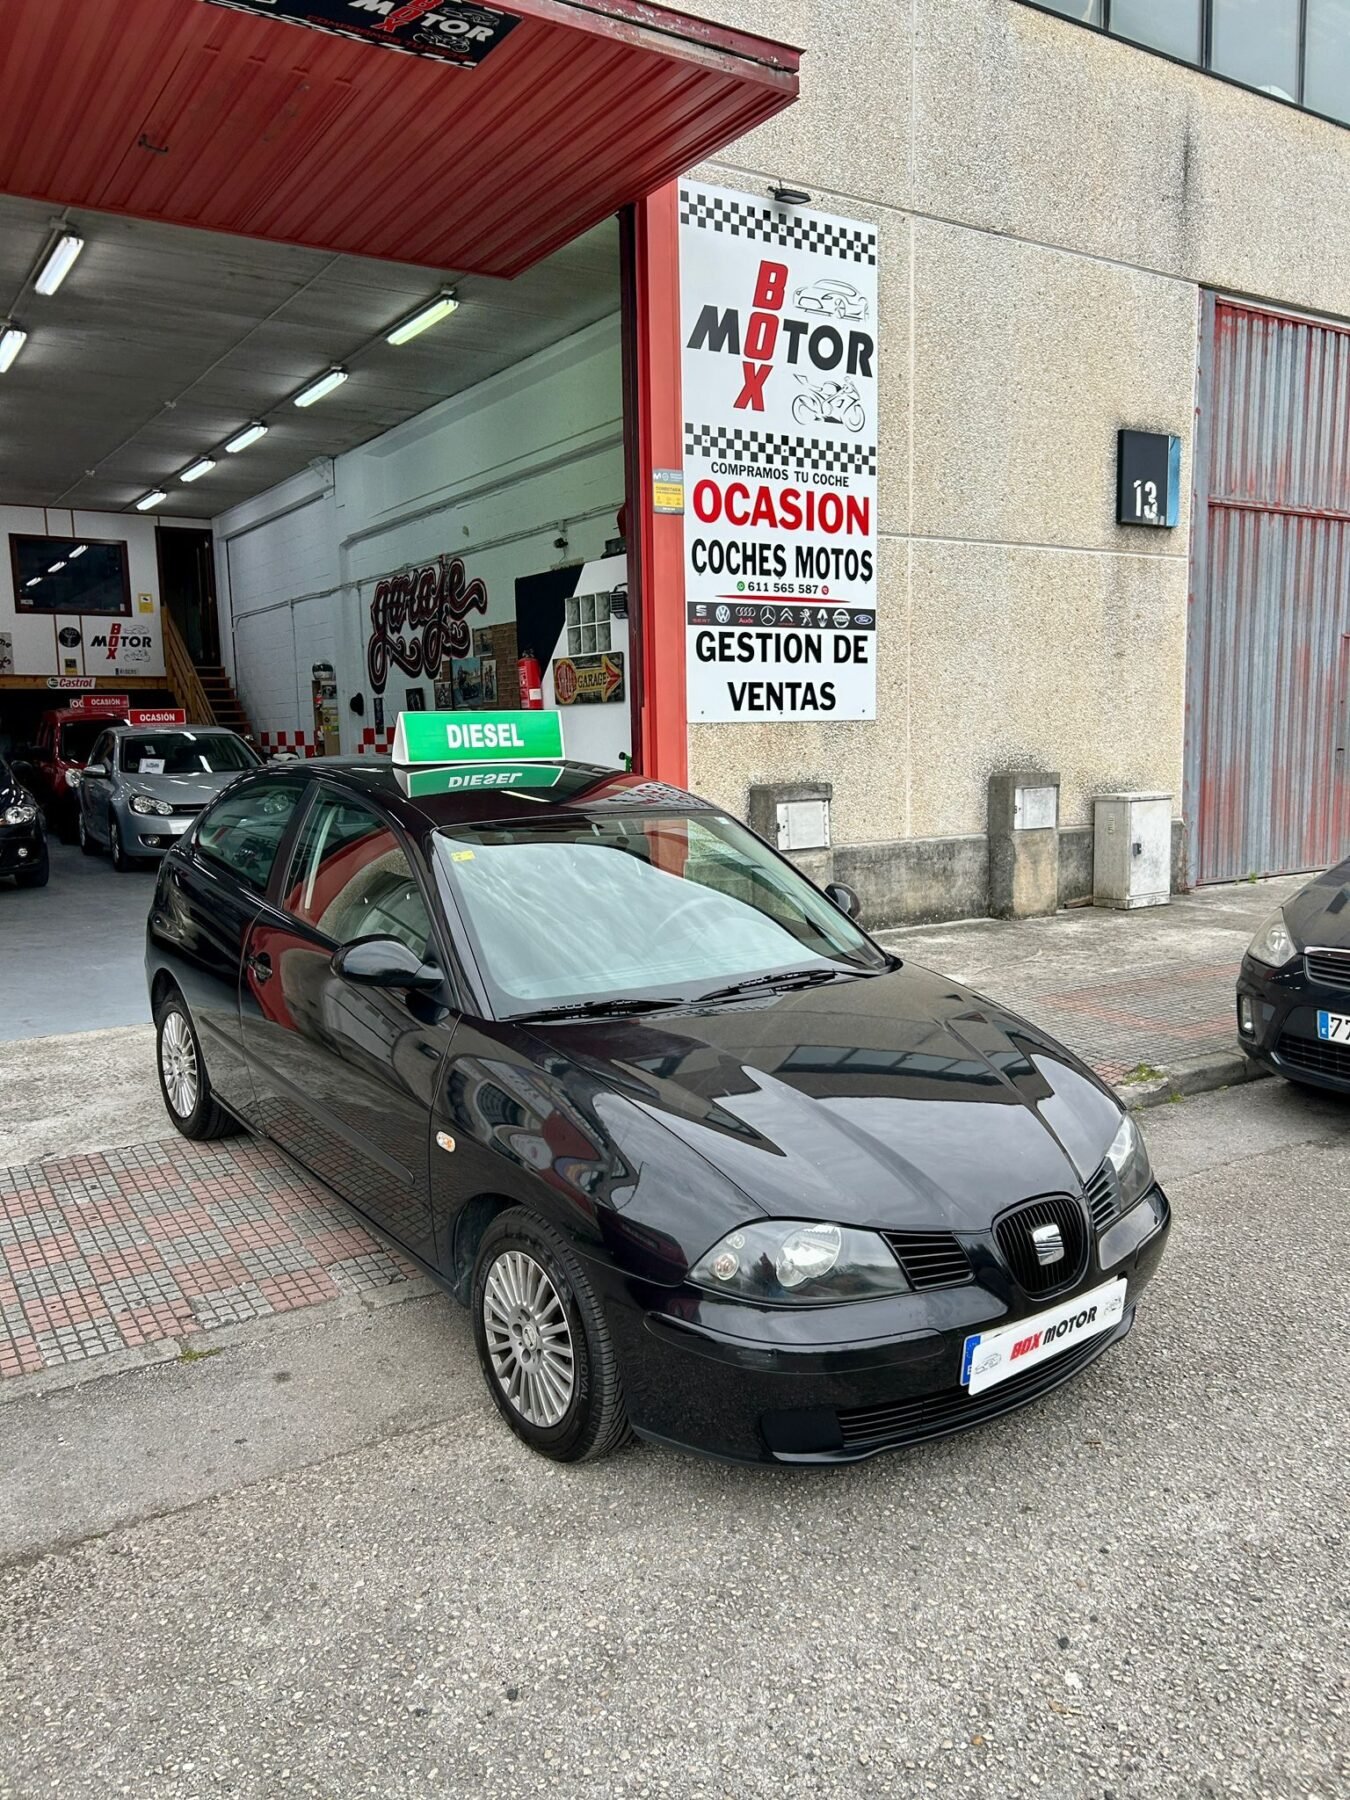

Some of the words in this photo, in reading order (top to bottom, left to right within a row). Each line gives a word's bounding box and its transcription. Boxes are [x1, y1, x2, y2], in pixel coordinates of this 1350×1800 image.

[686, 304, 874, 377] MOTOR
[733, 259, 788, 412] BOX
[711, 461, 789, 481] COMPRAMOS
[794, 470, 809, 483] TU
[812, 473, 849, 488] COCHE
[693, 479, 870, 536] OCASION
[1133, 479, 1158, 519] 13
[691, 538, 787, 577] COCHES
[795, 545, 873, 582] MOTOS
[748, 581, 769, 593] 611
[773, 583, 795, 594] 565
[798, 584, 819, 595] 587
[90, 635, 152, 648] MOTOR
[106, 623, 121, 660] BOX
[696, 630, 822, 663] GESTION
[833, 634, 868, 664] DE
[59, 678, 94, 688] Castrol
[577, 671, 607, 688] GARAGE
[727, 681, 836, 711] VENTAS
[139, 711, 175, 722] OCASIÓN
[446, 723, 524, 749] DIESEL
[1009, 1331, 1044, 1361] BOX
[1042, 1305, 1098, 1346] MOTOR
